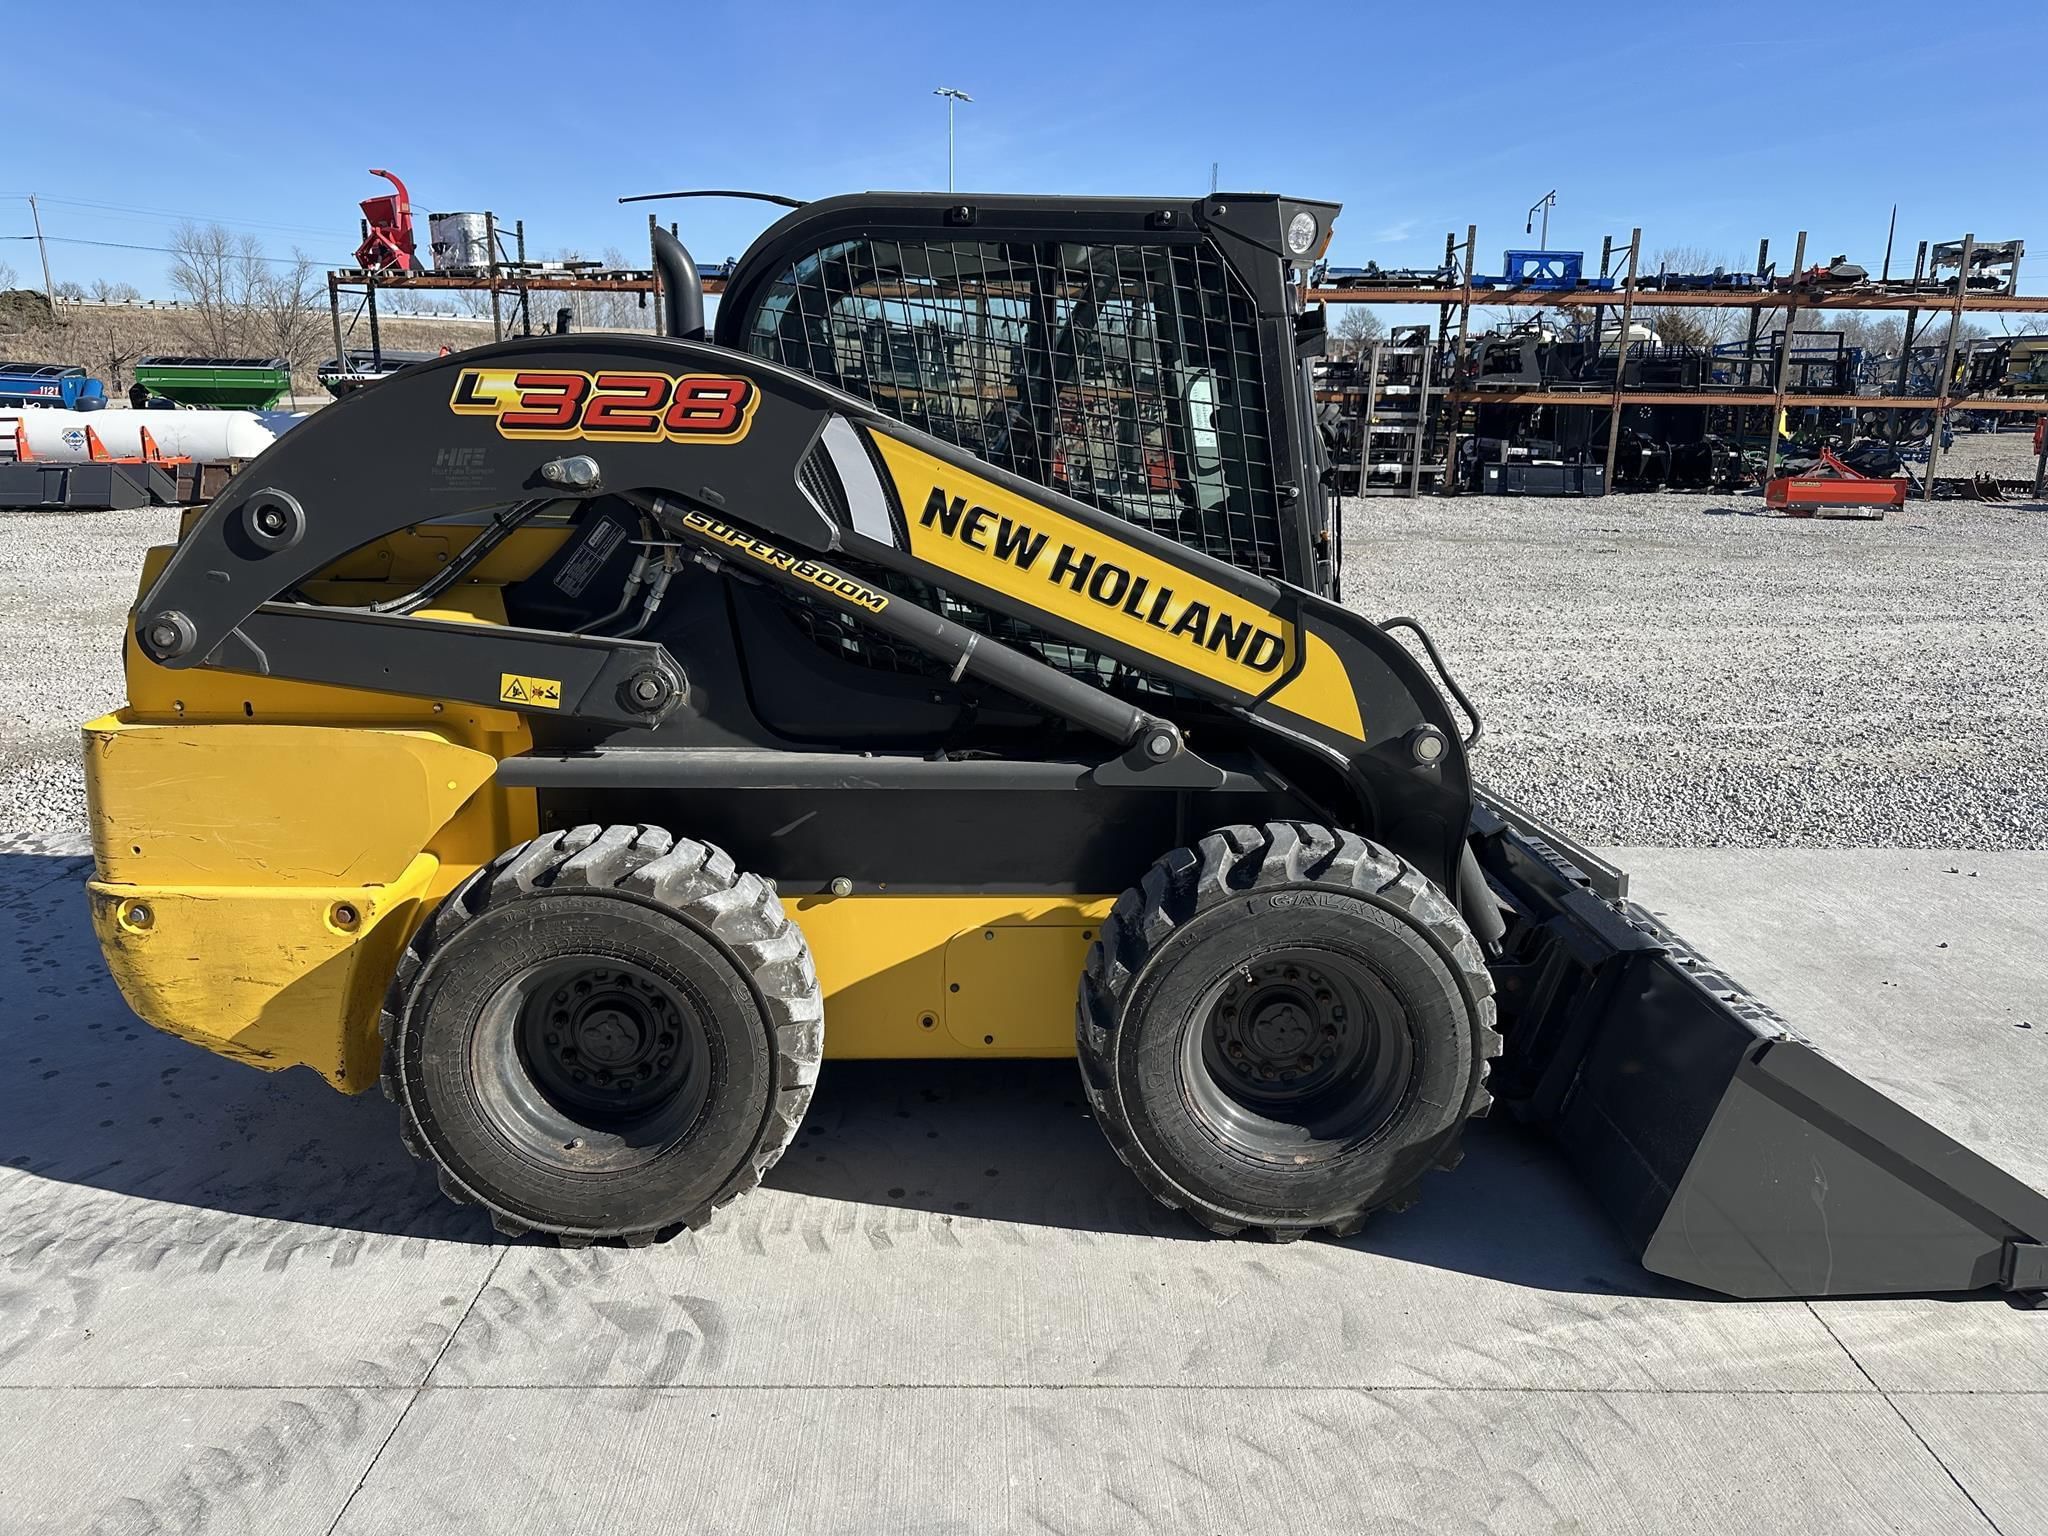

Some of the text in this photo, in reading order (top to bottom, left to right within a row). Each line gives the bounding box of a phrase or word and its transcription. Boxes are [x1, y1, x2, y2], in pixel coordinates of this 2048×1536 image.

[39, 386, 59, 395] 1121
[452, 369, 759, 442] L328
[920, 486, 1287, 674] NEW HOLLAND
